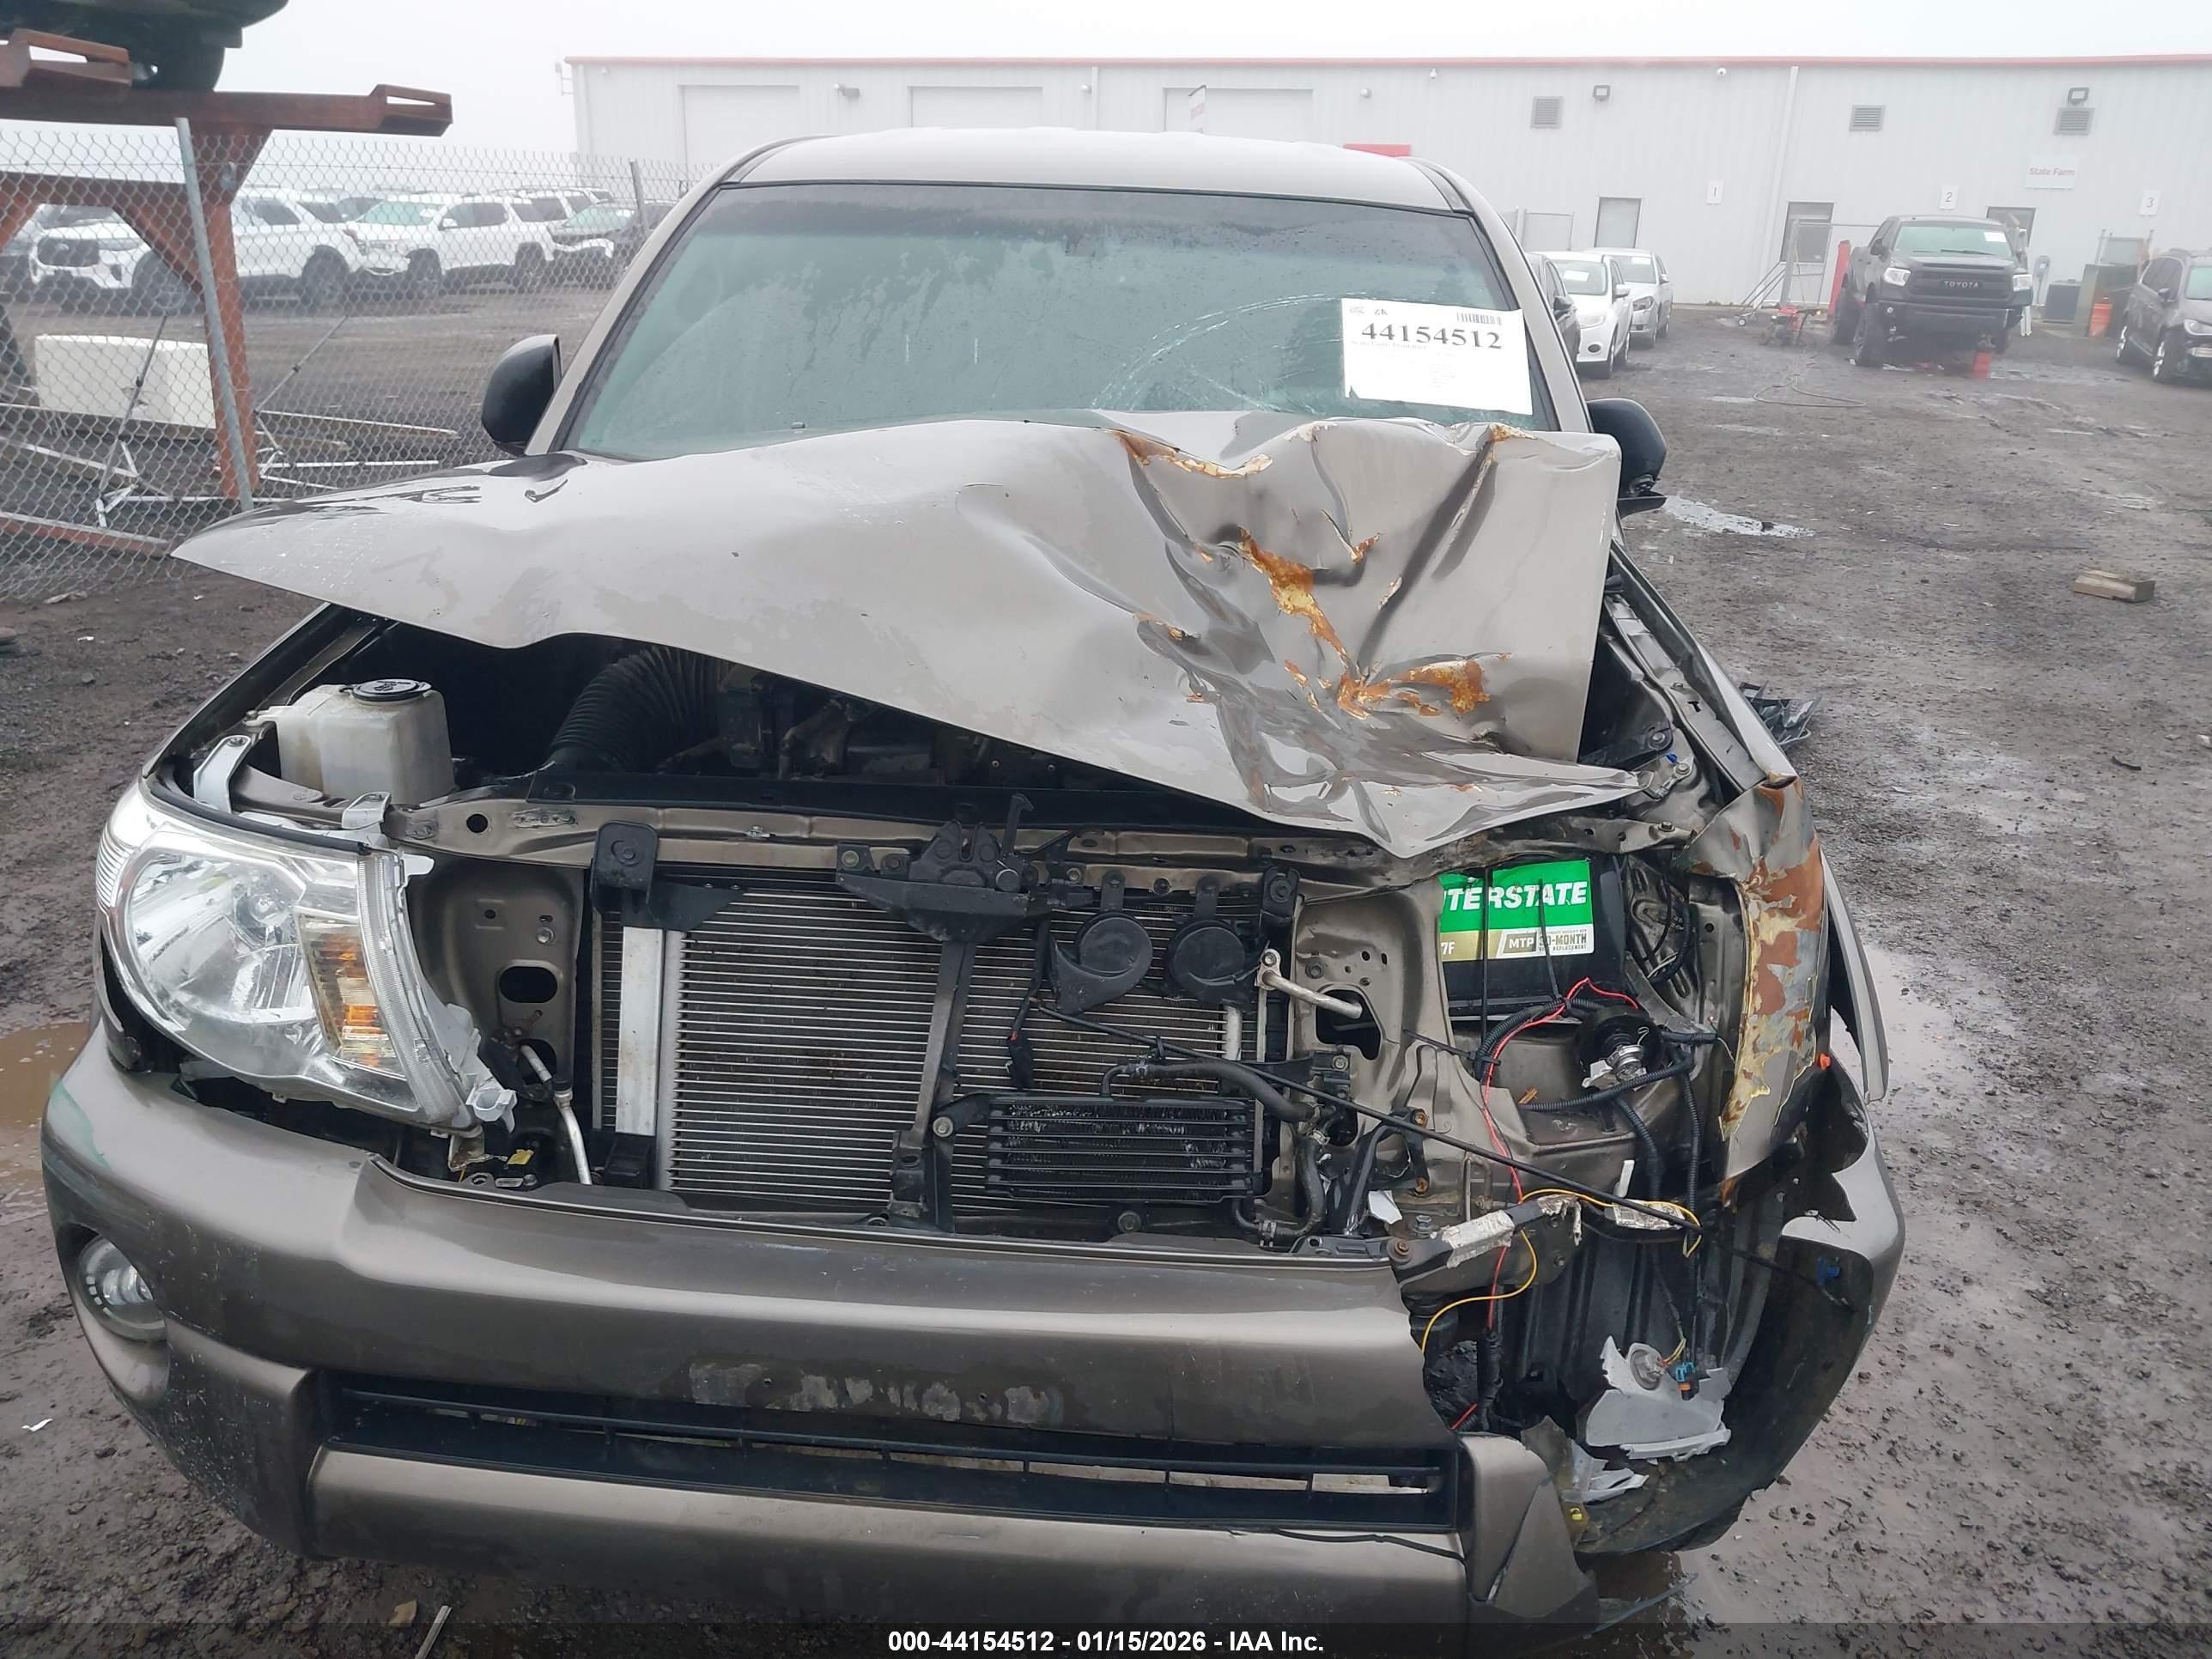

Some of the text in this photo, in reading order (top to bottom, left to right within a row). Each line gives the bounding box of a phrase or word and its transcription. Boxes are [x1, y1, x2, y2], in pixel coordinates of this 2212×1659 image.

[1945, 191, 1954, 203] 2
[2145, 197, 2154, 208] 3
[1943, 280, 1979, 289] TOYOTA
[1361, 322, 1503, 349] 44154512
[1509, 937, 1534, 949] MTP
